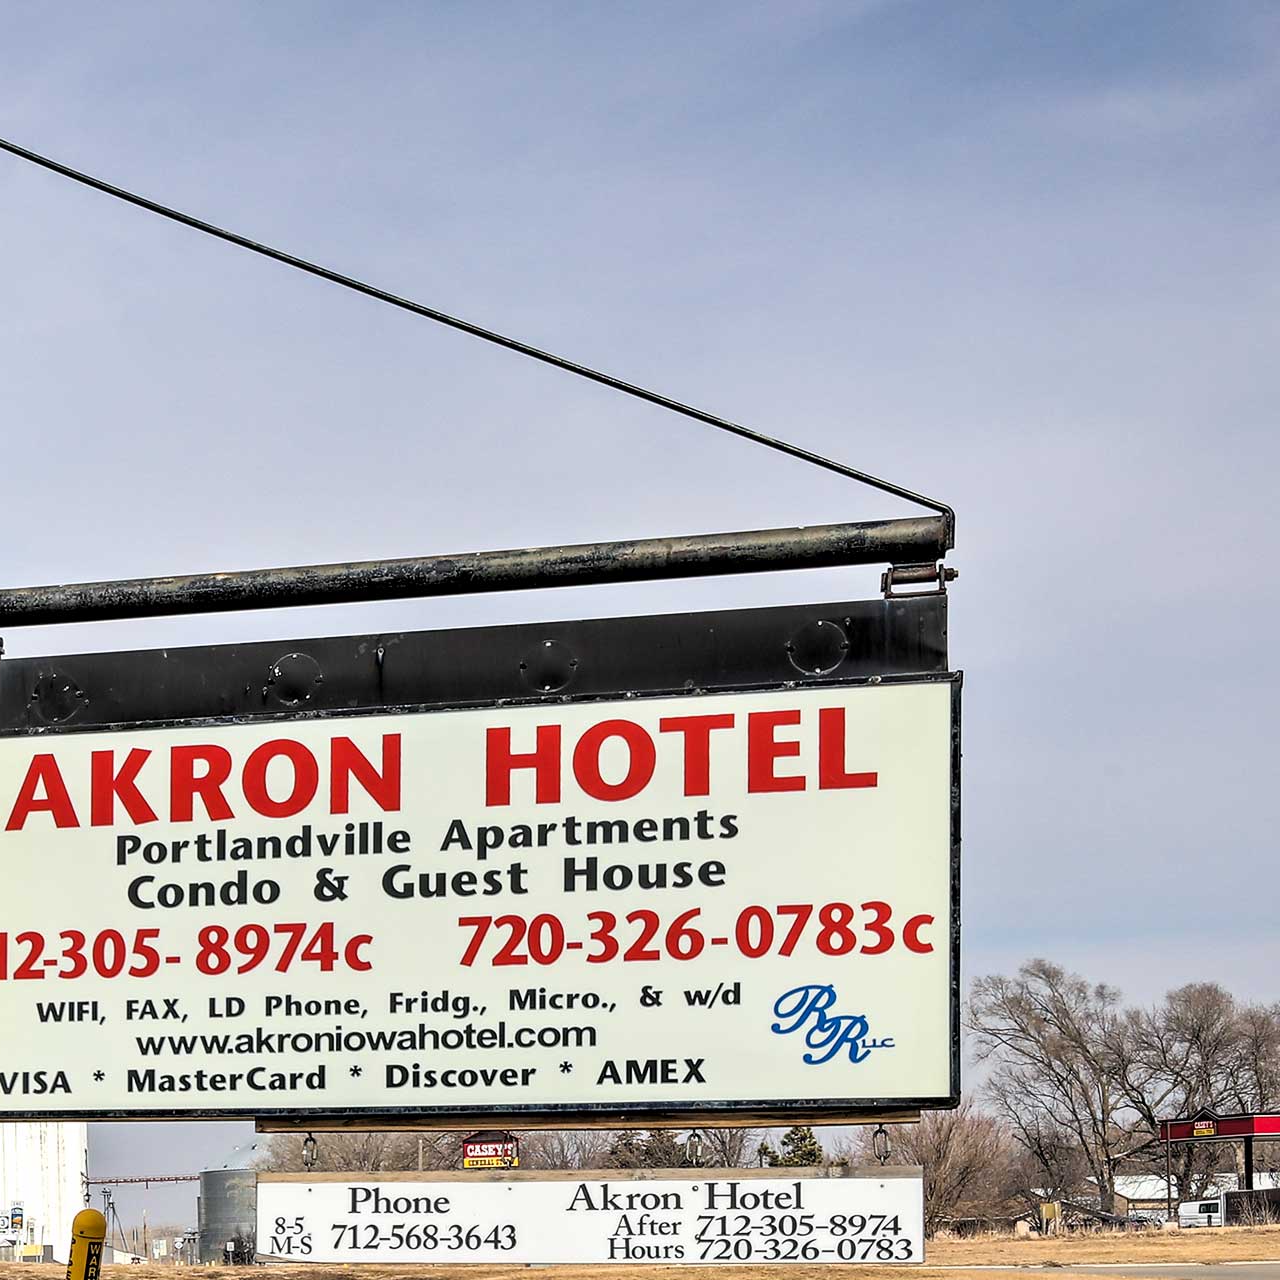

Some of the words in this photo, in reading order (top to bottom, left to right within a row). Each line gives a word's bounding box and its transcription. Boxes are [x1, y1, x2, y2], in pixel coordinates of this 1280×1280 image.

[4, 733, 402, 832] AKRON
[485, 707, 878, 807] HOTEL
[116, 822, 411, 866] Portlandville
[440, 810, 738, 857] Apartments
[128, 870, 280, 909] Condo
[314, 868, 349, 902] &
[382, 861, 528, 899] Guest
[564, 857, 725, 892] House
[459, 901, 934, 967] 720-326-0783c
[36, 1001, 105, 1025] WIFI,
[127, 999, 187, 1023] FAX,
[209, 997, 245, 1018] LD
[266, 995, 367, 1018] Phone,
[390, 990, 486, 1019] Fridg.,
[510, 988, 616, 1012] Micro.,
[640, 986, 663, 1007] &
[684, 982, 740, 1009] w/d
[136, 1022, 596, 1055] www.akroniowahotel.com
[861, 1038, 895, 1048] LLC
[128, 1065, 325, 1092] MasterCard
[386, 1063, 536, 1088] Discover
[597, 1059, 706, 1085] AMEX
[466, 1143, 513, 1157] CASEY'S
[348, 1188, 449, 1213] Phone
[566, 1184, 683, 1211] Akron
[705, 1182, 804, 1209] Hotel
[275, 1217, 304, 1234] 8-5
[331, 1224, 516, 1250] 712-568-3643
[614, 1214, 681, 1236] After
[695, 1215, 901, 1237] 712-305-8974
[269, 1235, 313, 1255] M-S
[608, 1238, 684, 1259] Hours
[695, 1237, 912, 1260] 720-326-0783
